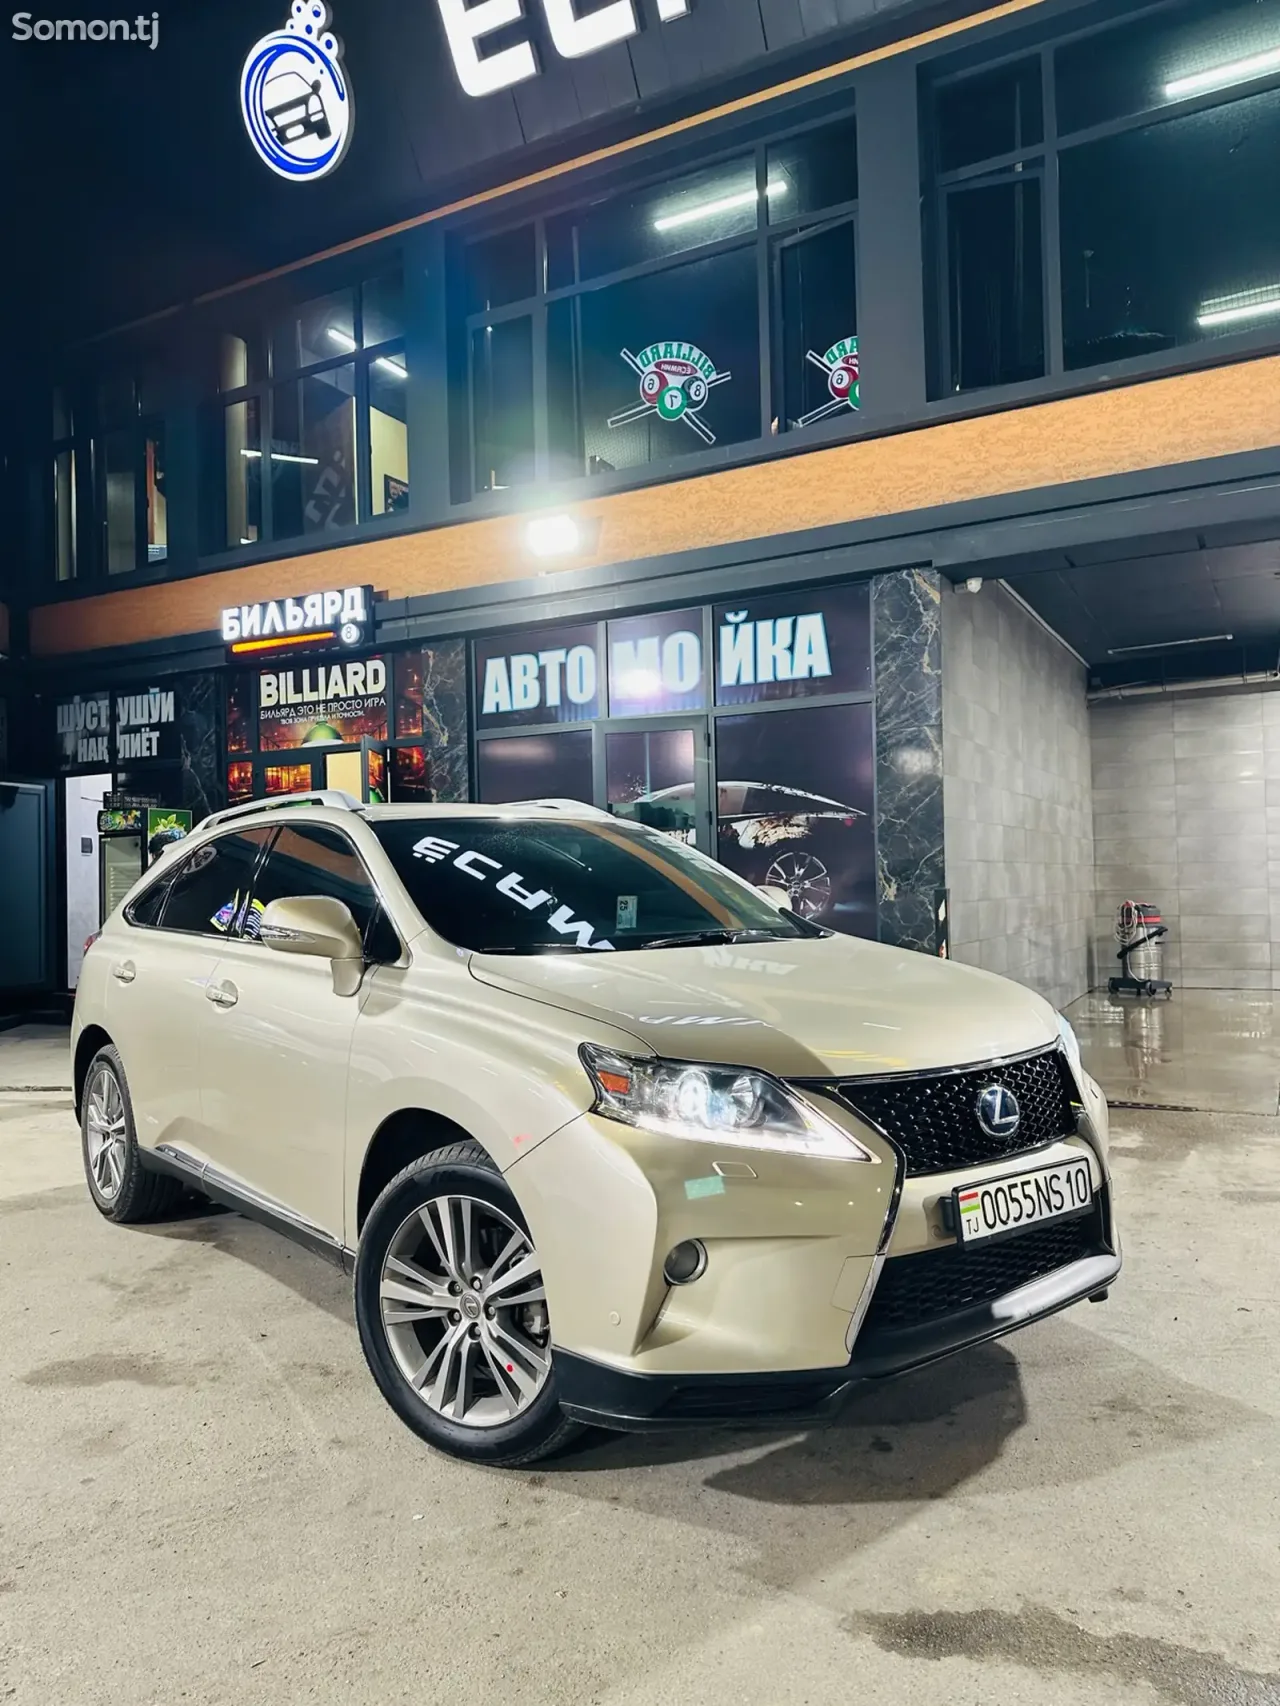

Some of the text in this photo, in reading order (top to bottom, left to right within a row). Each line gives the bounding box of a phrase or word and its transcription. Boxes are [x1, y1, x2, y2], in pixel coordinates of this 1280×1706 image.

[221, 586, 367, 641] БИЛЬЯРД
[260, 659, 386, 708] BILLIARD
[260, 697, 387, 720] БИЛЬЯРД ЭТО НЕ ПРОСТО ИГРА
[619, 900, 629, 912] 25
[966, 1216, 981, 1235] TJ
